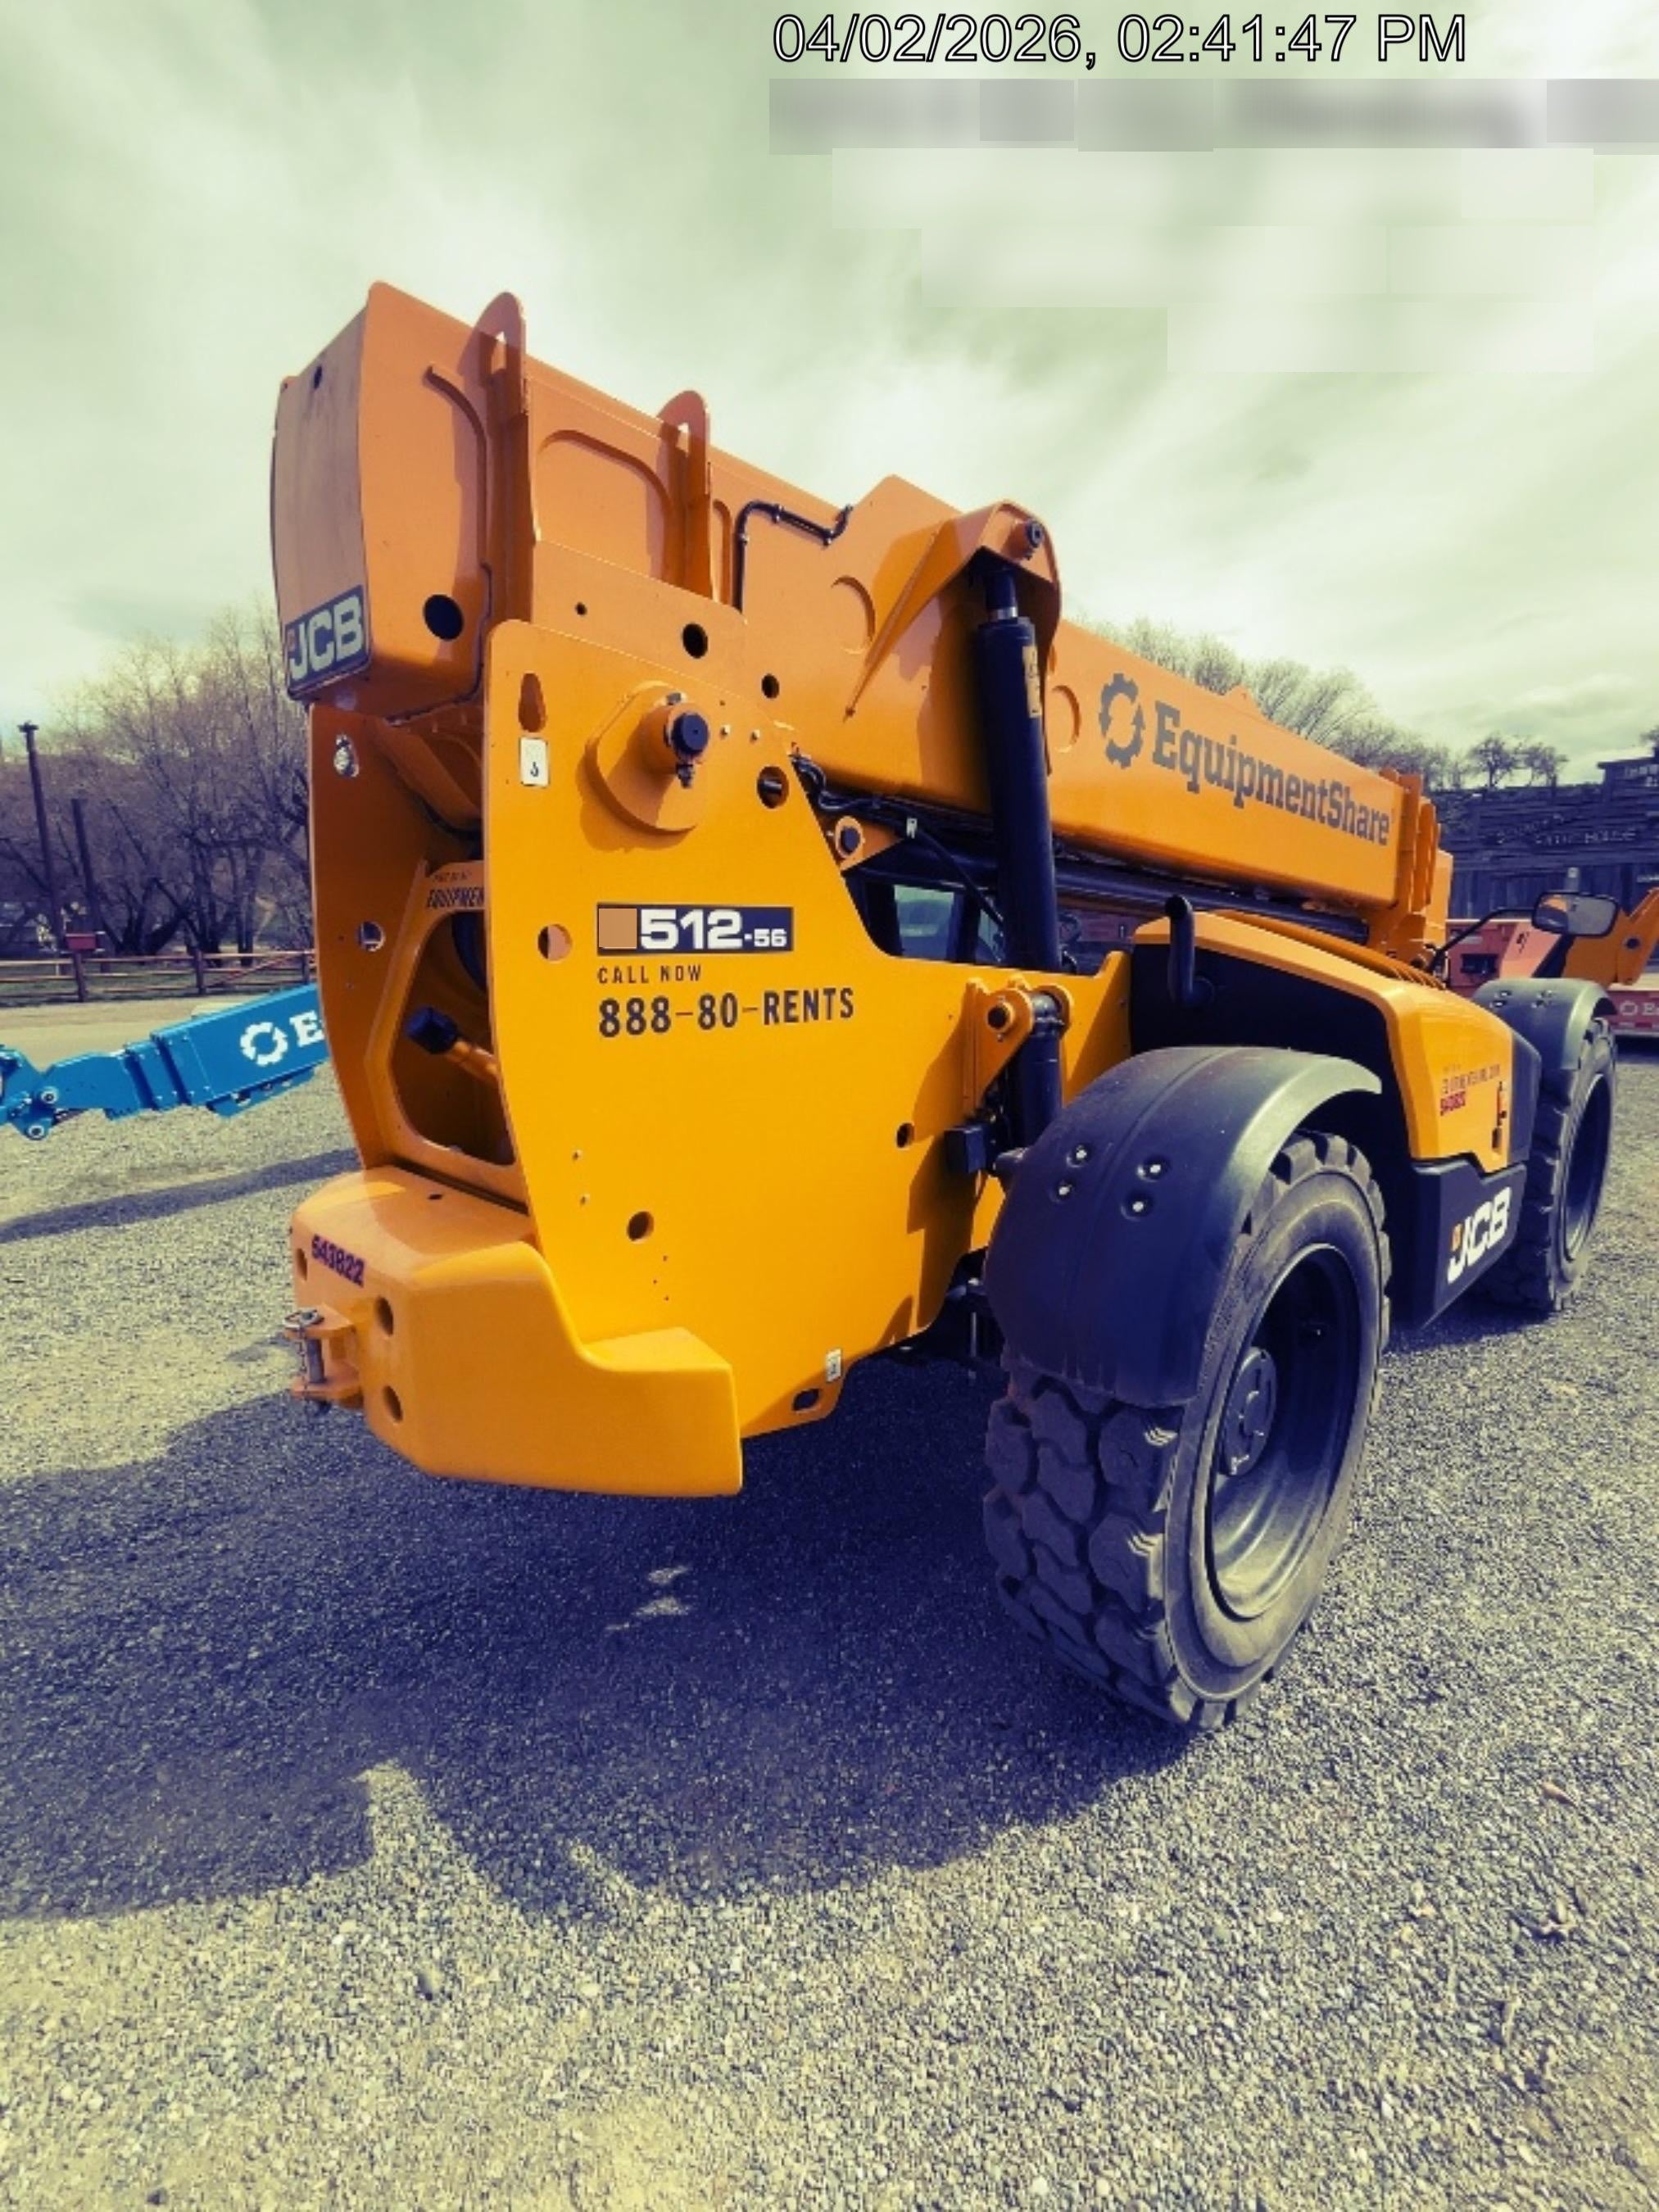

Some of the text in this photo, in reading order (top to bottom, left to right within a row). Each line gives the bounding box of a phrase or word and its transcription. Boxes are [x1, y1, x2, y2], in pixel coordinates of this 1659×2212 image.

[288, 595, 364, 681] JCB
[1153, 701, 1389, 846] EquipmentShare
[640, 908, 787, 950] 512-56
[597, 963, 702, 984] CALL NOW
[599, 987, 854, 1038] 888-80-RENTS
[312, 1233, 364, 1288] 543822
[1447, 1185, 1512, 1285] JCB
